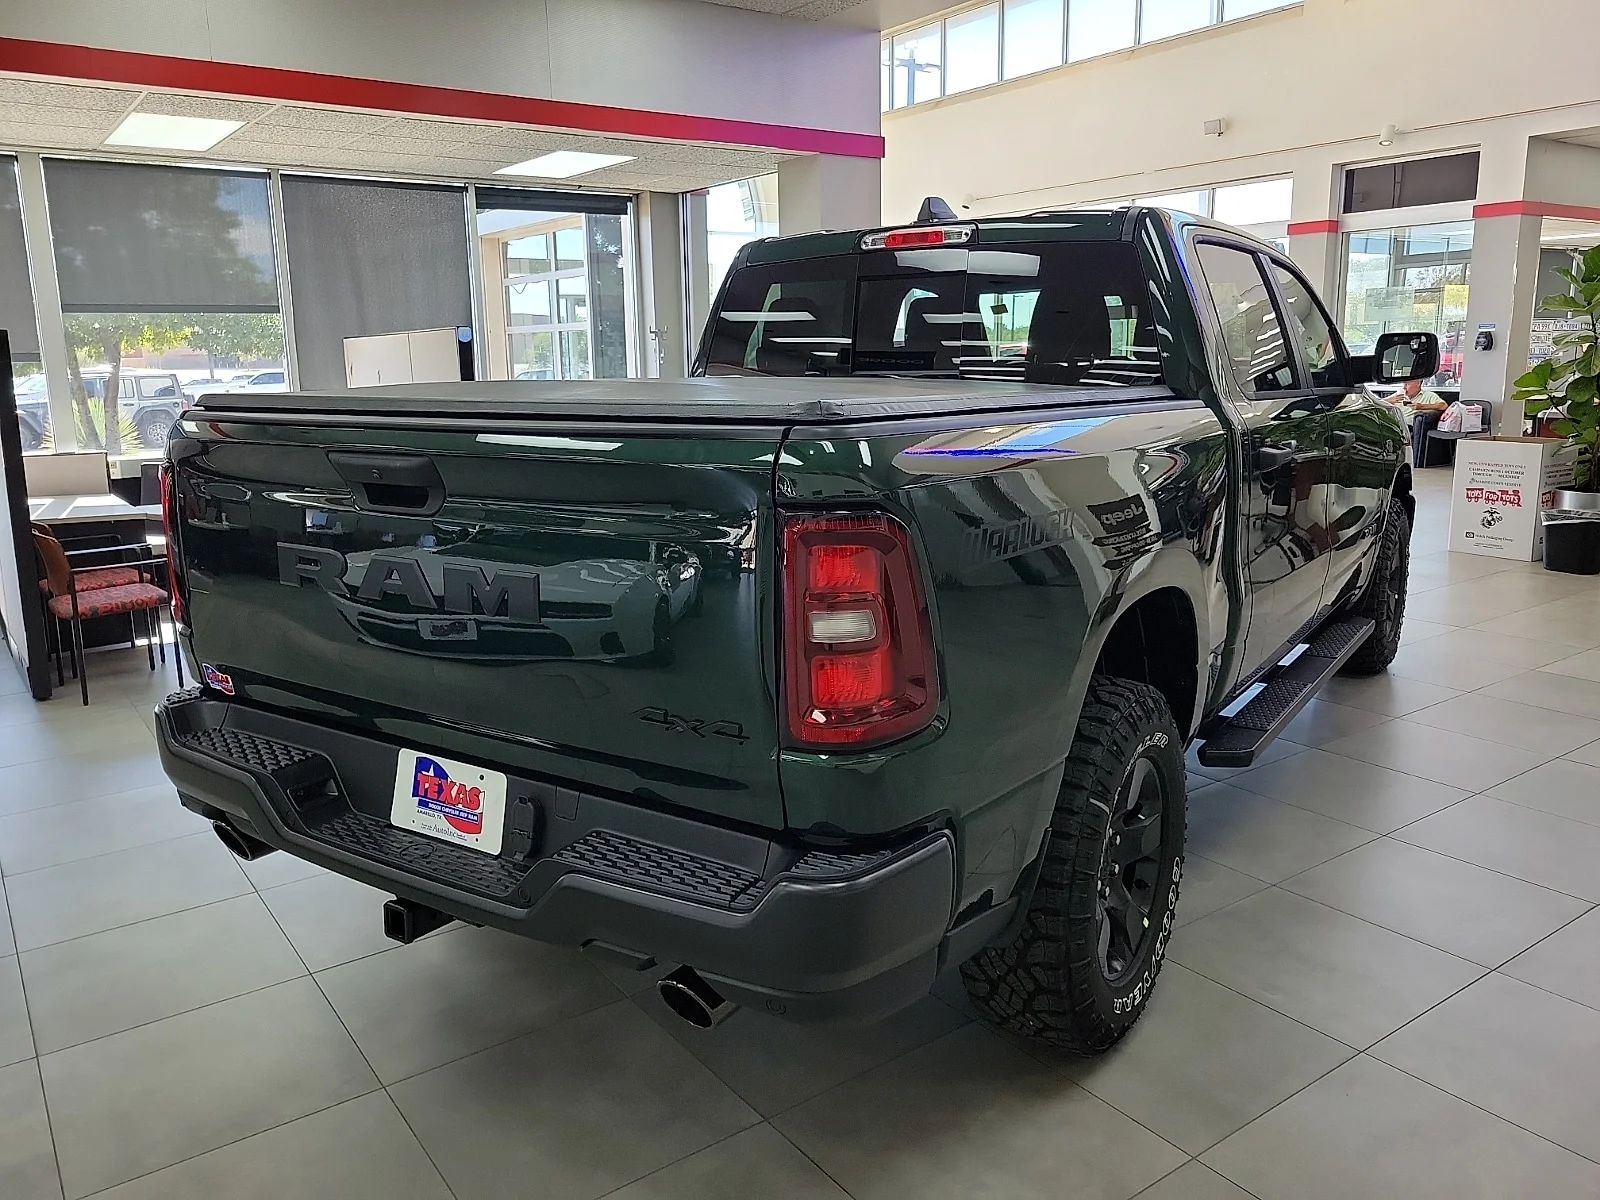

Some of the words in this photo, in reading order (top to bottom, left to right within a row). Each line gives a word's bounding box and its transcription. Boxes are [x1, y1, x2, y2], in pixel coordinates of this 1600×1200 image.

[1467, 489, 1482, 498] TOYS
[1485, 492, 1498, 501] FOR
[1501, 494, 1519, 504] TOTS
[962, 508, 1075, 561] WARLOCK
[276, 541, 541, 624] RAM
[417, 772, 482, 811] TEXAS
[1113, 856, 1181, 1015] GOODYEAR
